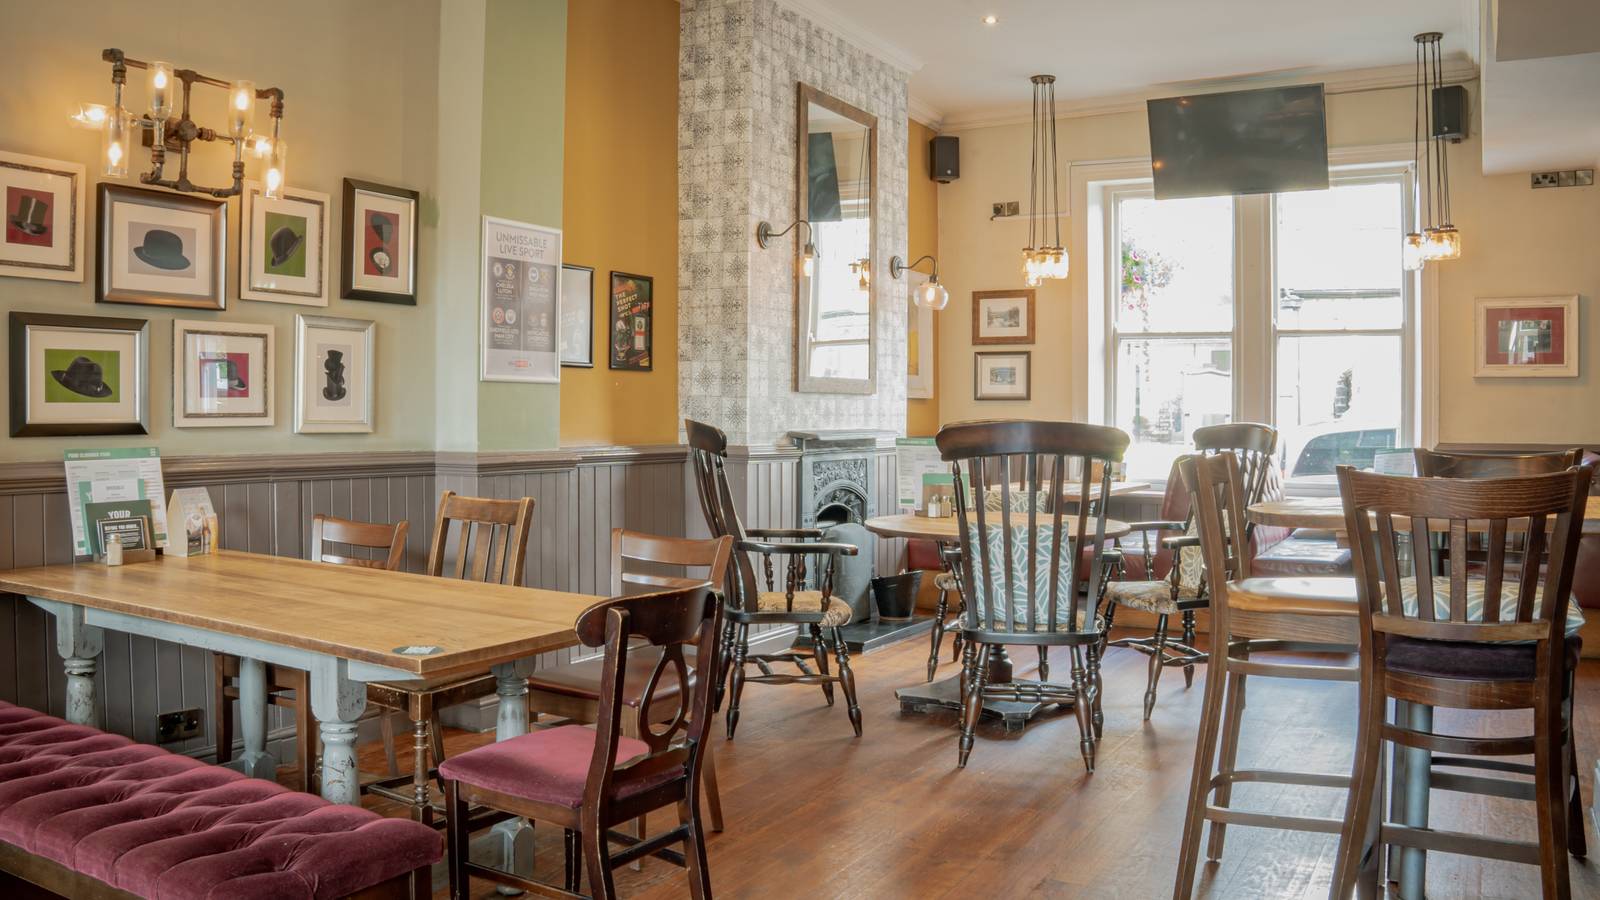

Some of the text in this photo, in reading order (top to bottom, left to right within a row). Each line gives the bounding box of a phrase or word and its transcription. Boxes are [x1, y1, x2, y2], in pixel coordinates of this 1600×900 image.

[496, 231, 546, 249] UNMISSABLE
[499, 243, 544, 260] LIVE SPORT
[616, 291, 626, 301] THE
[616, 293, 638, 306] PERFECT
[617, 302, 632, 313] SHOT
[107, 510, 131, 519] YOUR
